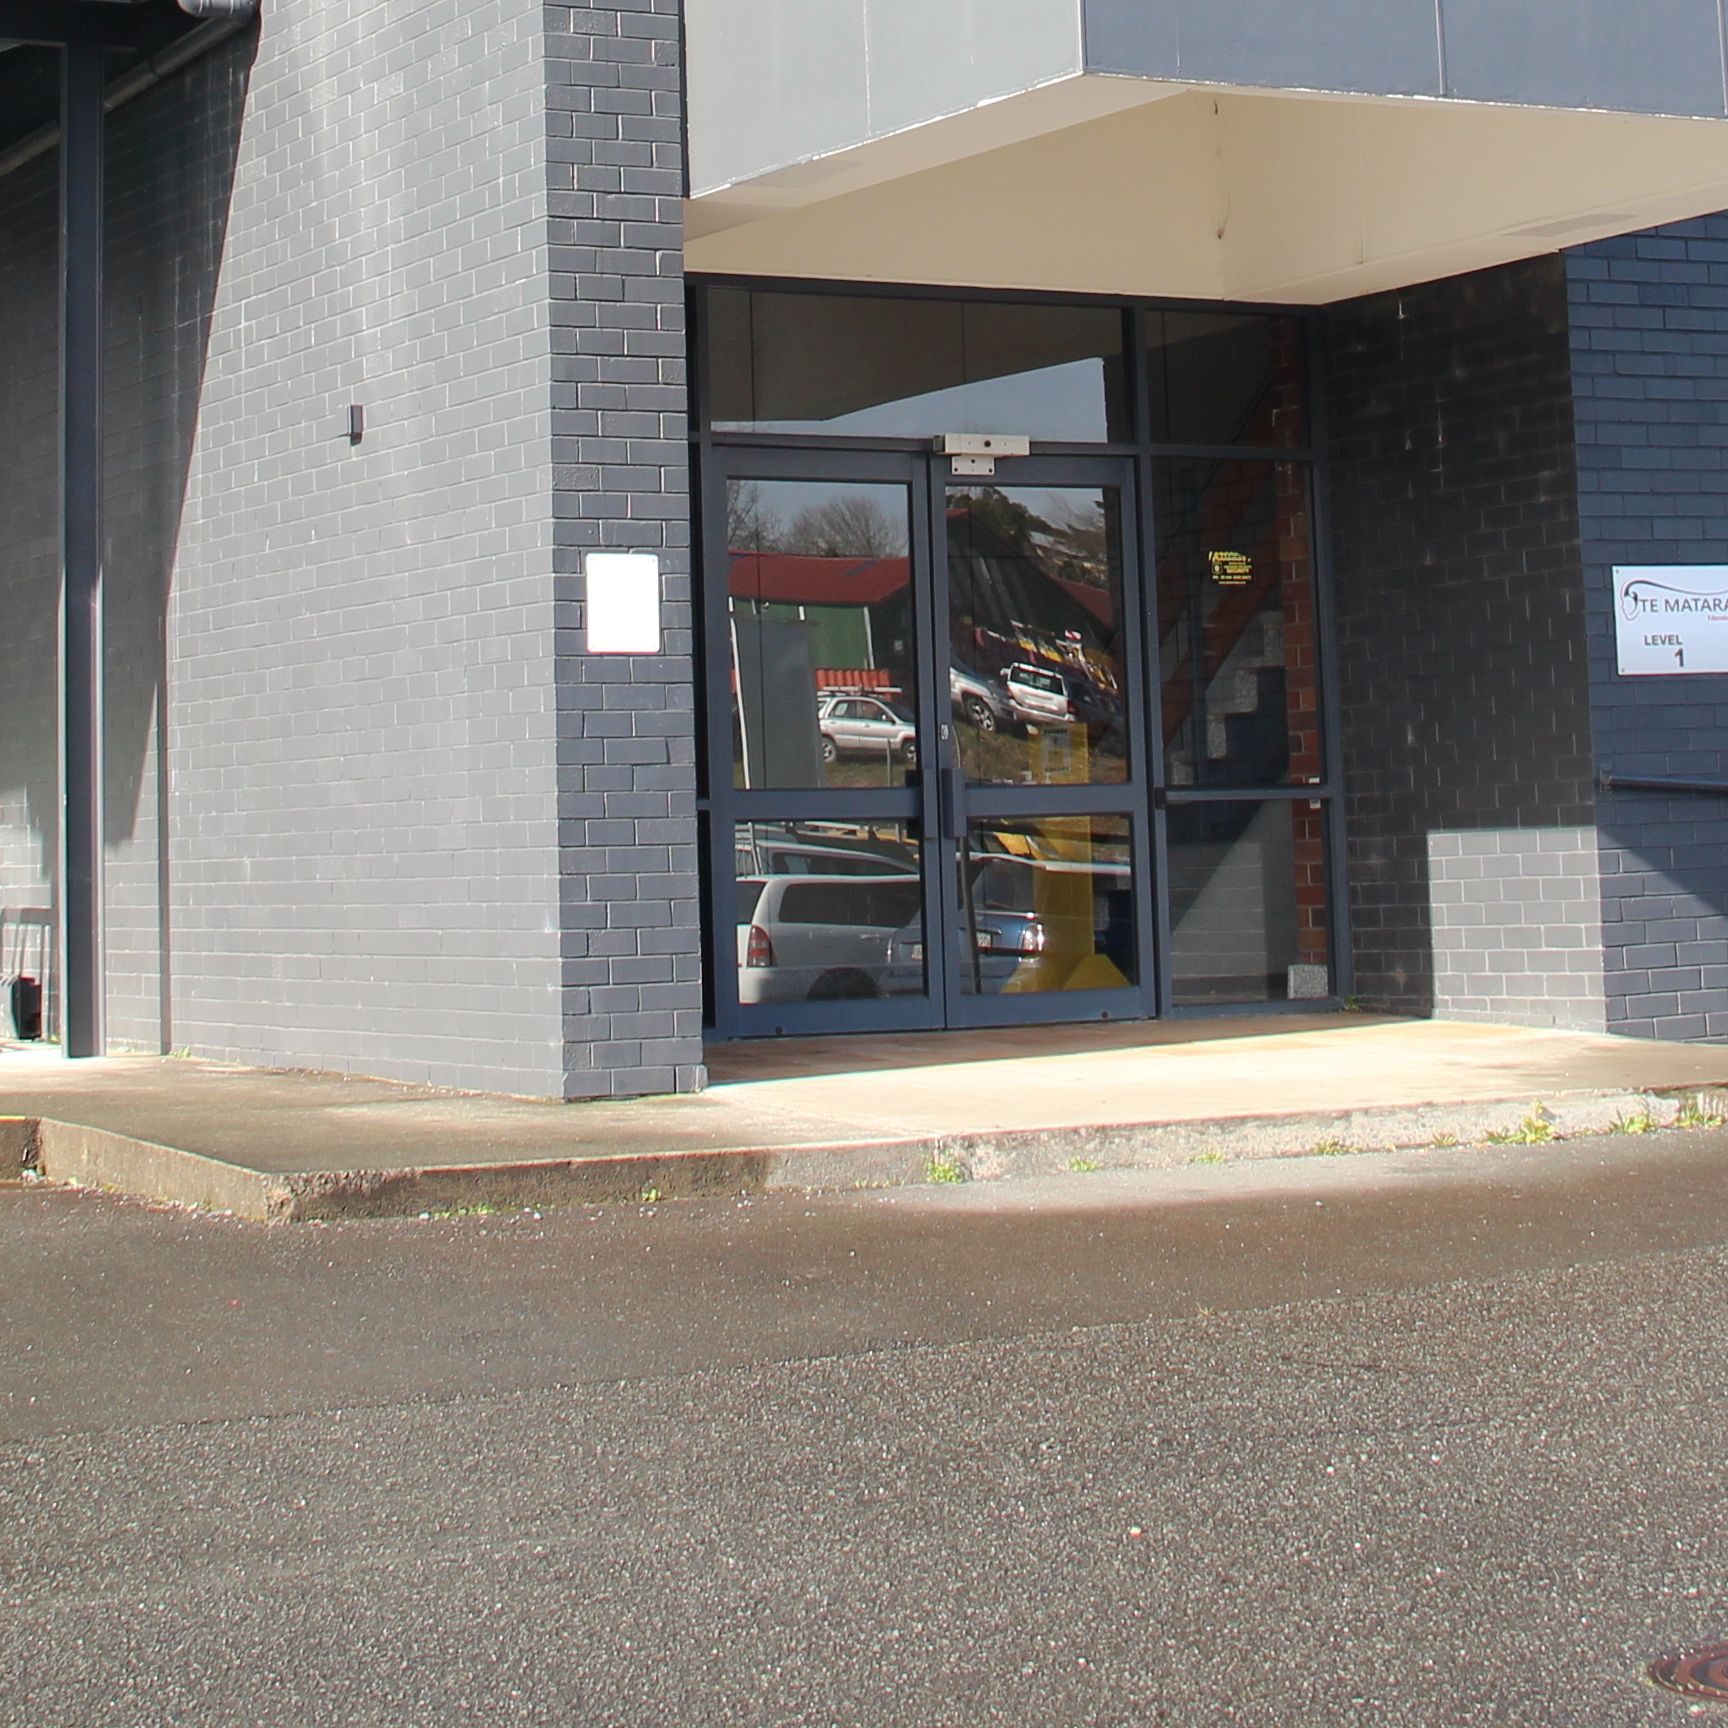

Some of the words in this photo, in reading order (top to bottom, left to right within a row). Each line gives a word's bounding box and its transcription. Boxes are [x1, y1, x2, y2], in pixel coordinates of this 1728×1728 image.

[1638, 598, 1660, 613] TE
[1643, 634, 1683, 646] LEVEL
[1674, 648, 1685, 668] 1
